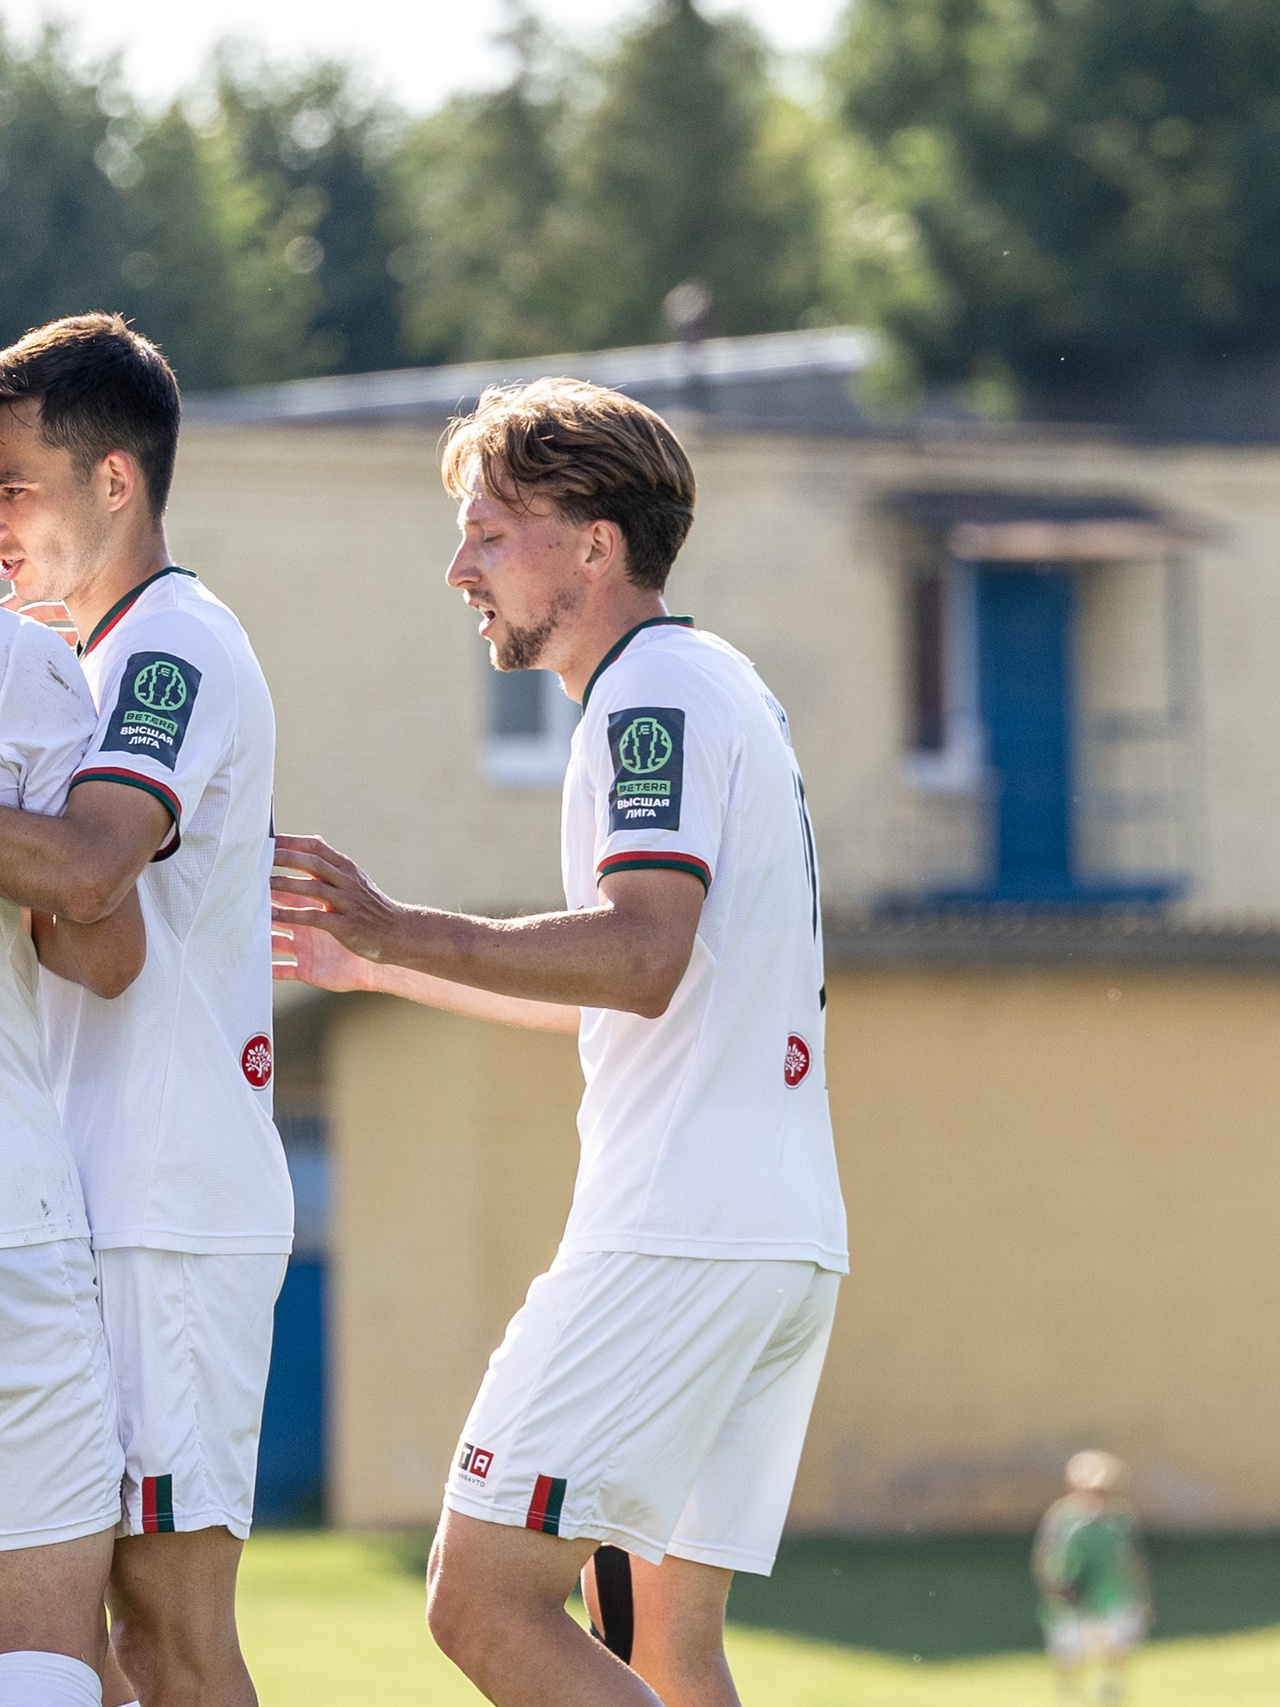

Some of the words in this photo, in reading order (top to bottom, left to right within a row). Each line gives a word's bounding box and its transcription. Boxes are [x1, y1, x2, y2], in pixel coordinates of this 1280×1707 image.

[121, 726, 173, 745] ВЫСШАЯ
[128, 735, 160, 749] ЛИГА
[617, 797, 670, 810] ВЫСШАЯ
[625, 808, 656, 819] ЛИГА
